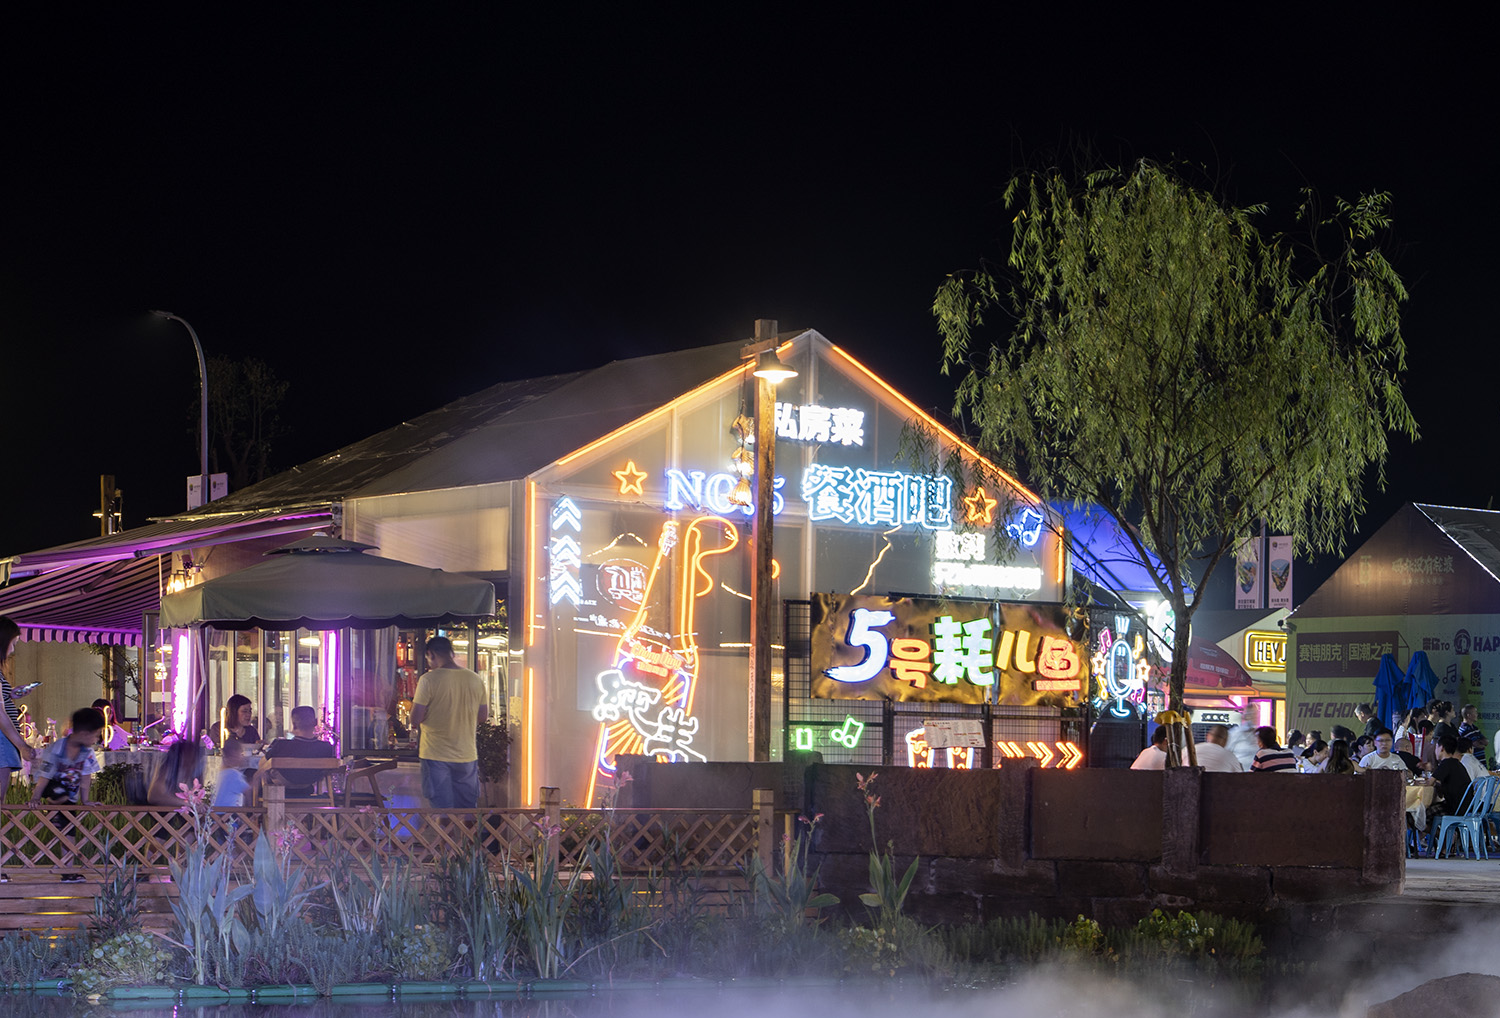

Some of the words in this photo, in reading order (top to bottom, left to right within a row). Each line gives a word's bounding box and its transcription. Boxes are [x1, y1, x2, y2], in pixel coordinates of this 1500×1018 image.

[774, 401, 865, 446] 私房菜
[801, 463, 952, 530] 餐酒吧
[1254, 640, 1279, 663] HEY
[1299, 643, 1342, 662] 赛博朋克
[1297, 702, 1323, 718] THE
